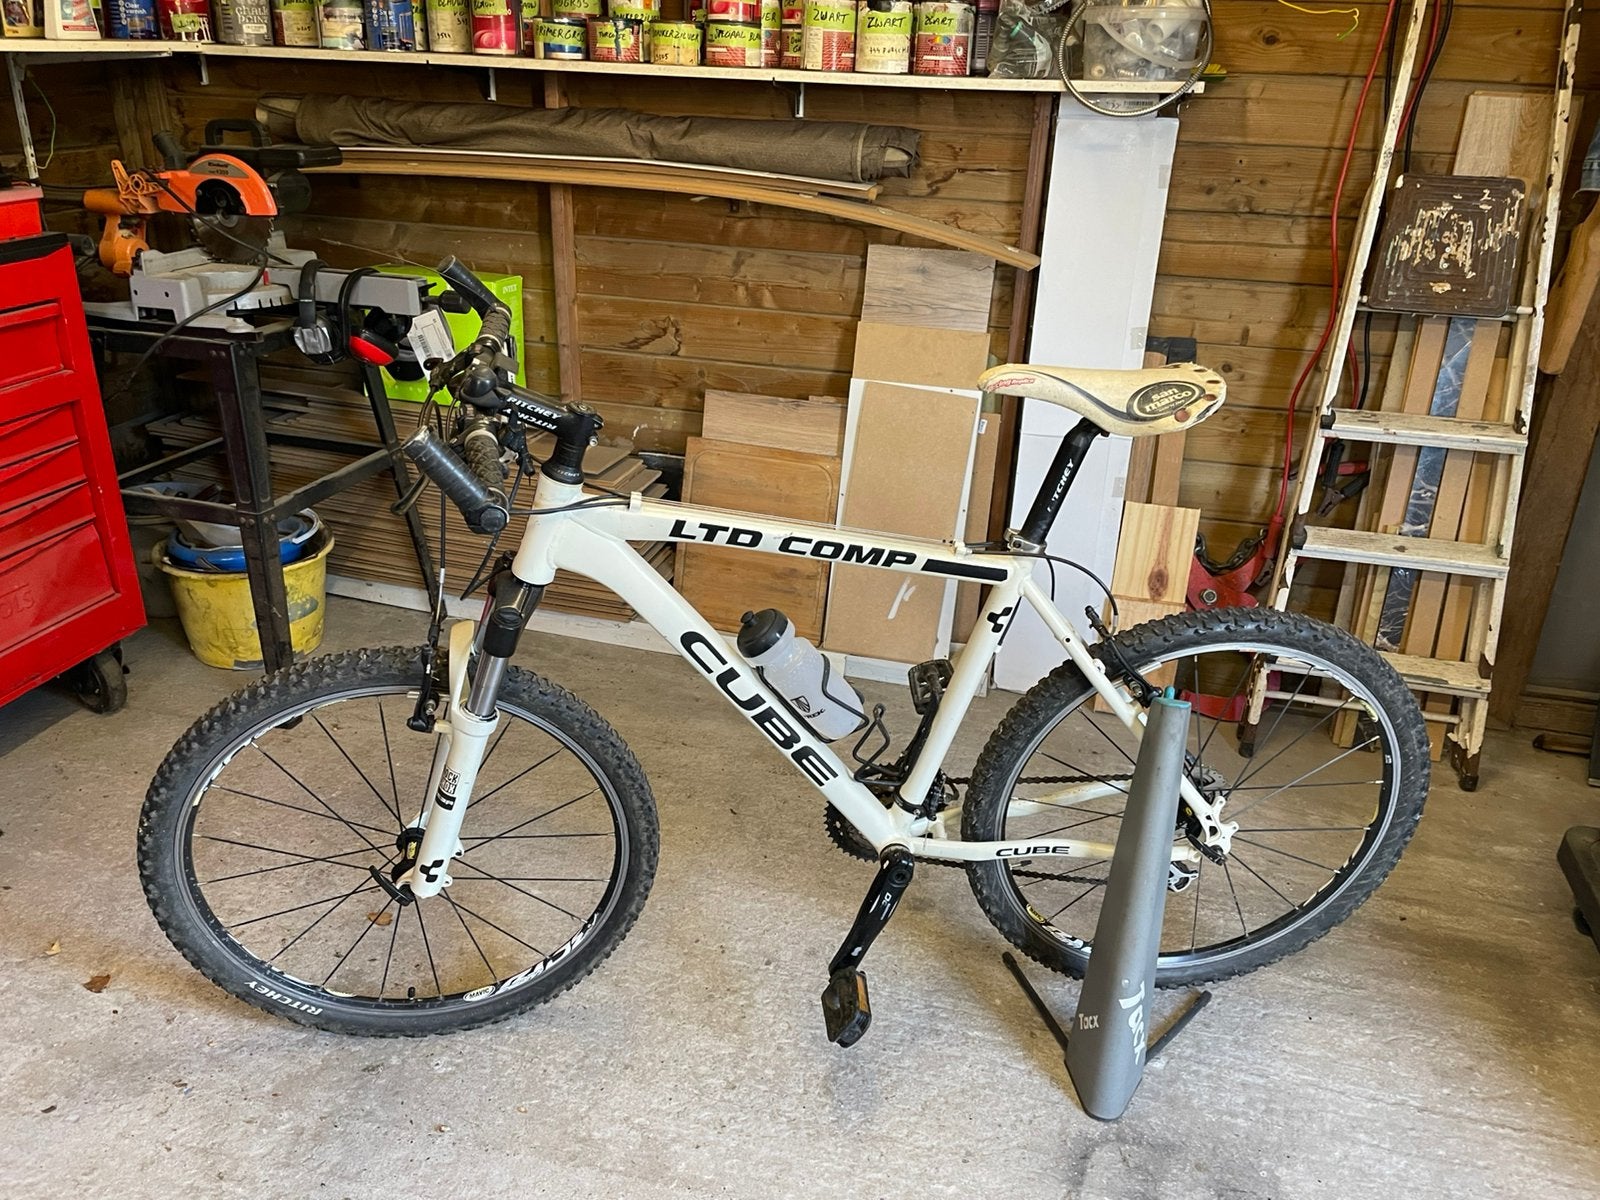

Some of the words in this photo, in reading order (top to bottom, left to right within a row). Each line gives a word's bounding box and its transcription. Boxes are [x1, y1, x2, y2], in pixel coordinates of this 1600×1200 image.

[813, 8, 850, 24] ZWART
[867, 16, 907, 29] ZWART
[923, 15, 954, 27] ZWART
[1144, 391, 1192, 413] marco
[1151, 388, 1179, 402] san
[506, 397, 562, 419] RITCHEY
[502, 408, 557, 430] RITCHY
[1046, 458, 1074, 513] TCHEY
[669, 519, 763, 548] LTD
[778, 536, 918, 567] COMP
[680, 631, 839, 787] CUBE
[995, 846, 1070, 857] CUBE
[244, 981, 323, 1015] RITCHEY
[469, 987, 491, 999] MAVIC
[1079, 1013, 1099, 1030] Tacx
